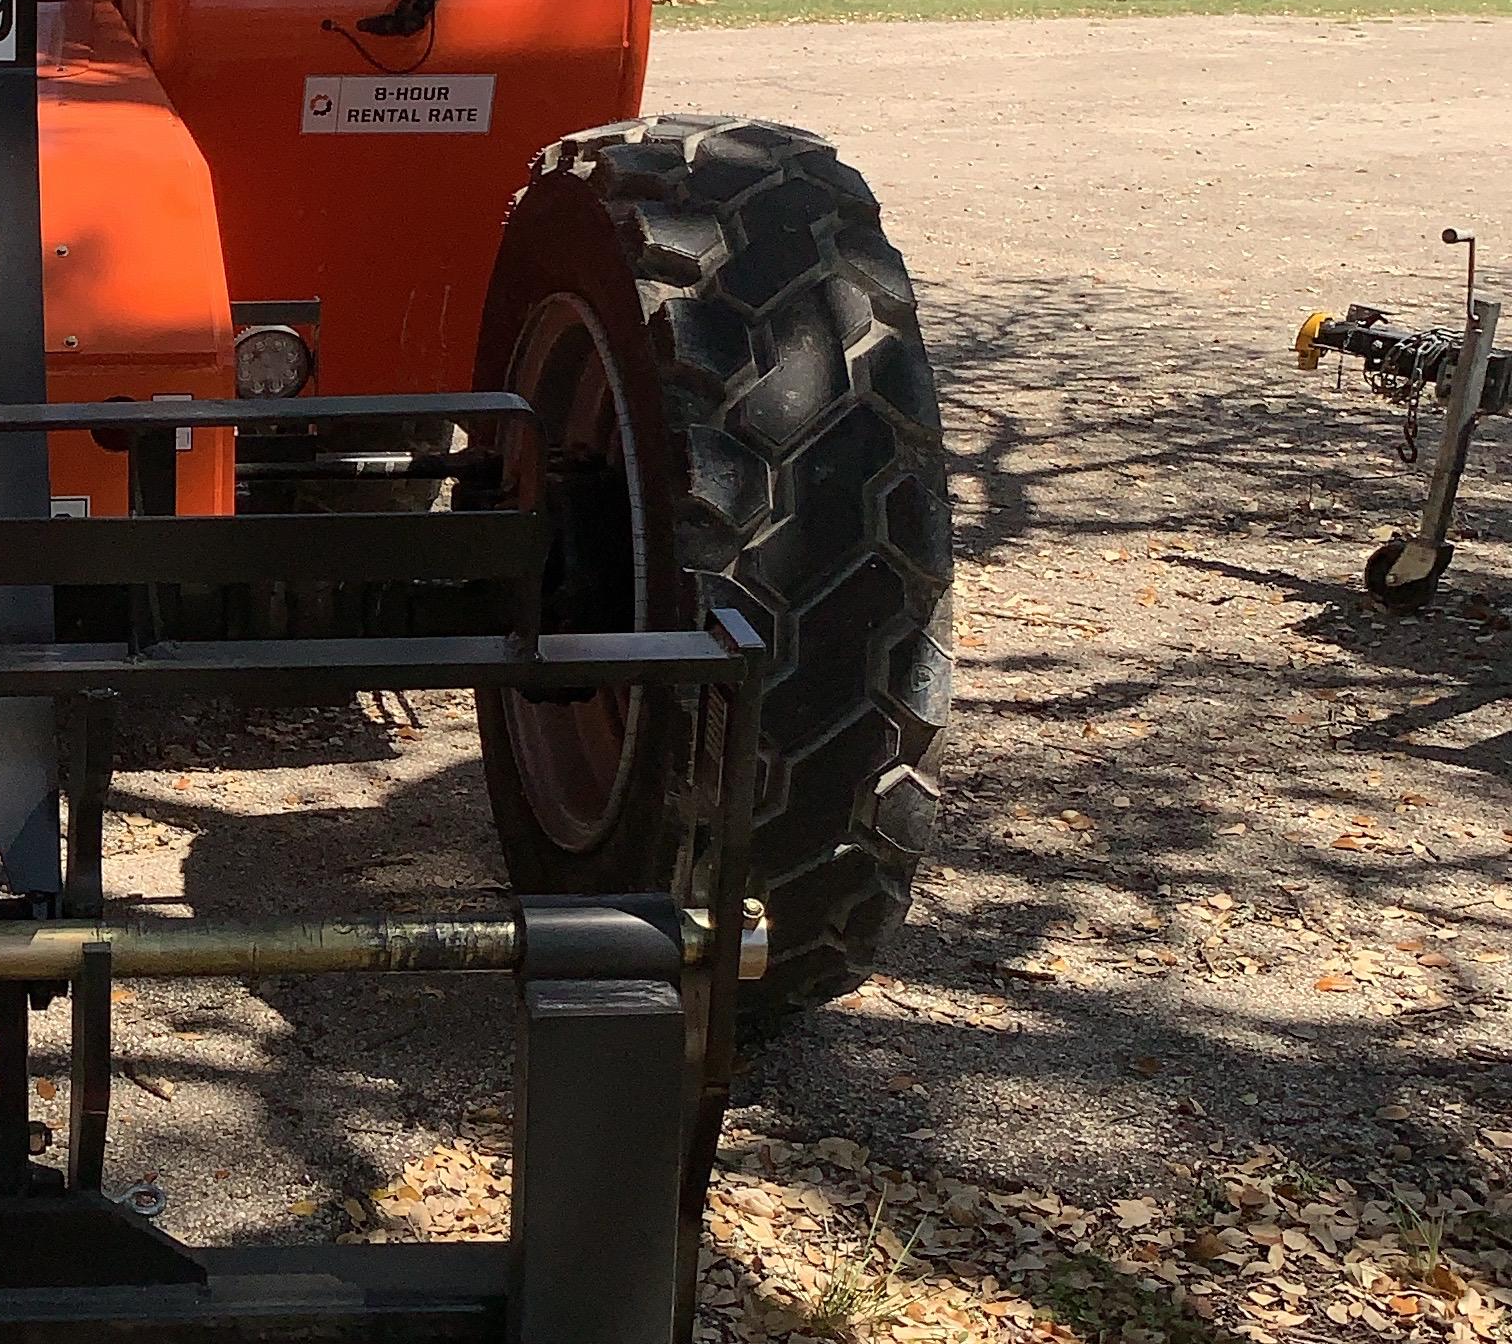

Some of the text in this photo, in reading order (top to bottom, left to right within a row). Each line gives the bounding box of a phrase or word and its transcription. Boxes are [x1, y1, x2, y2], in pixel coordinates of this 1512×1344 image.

[374, 86, 450, 101] 8-HOUR
[347, 108, 478, 123] RENTAL RATE
